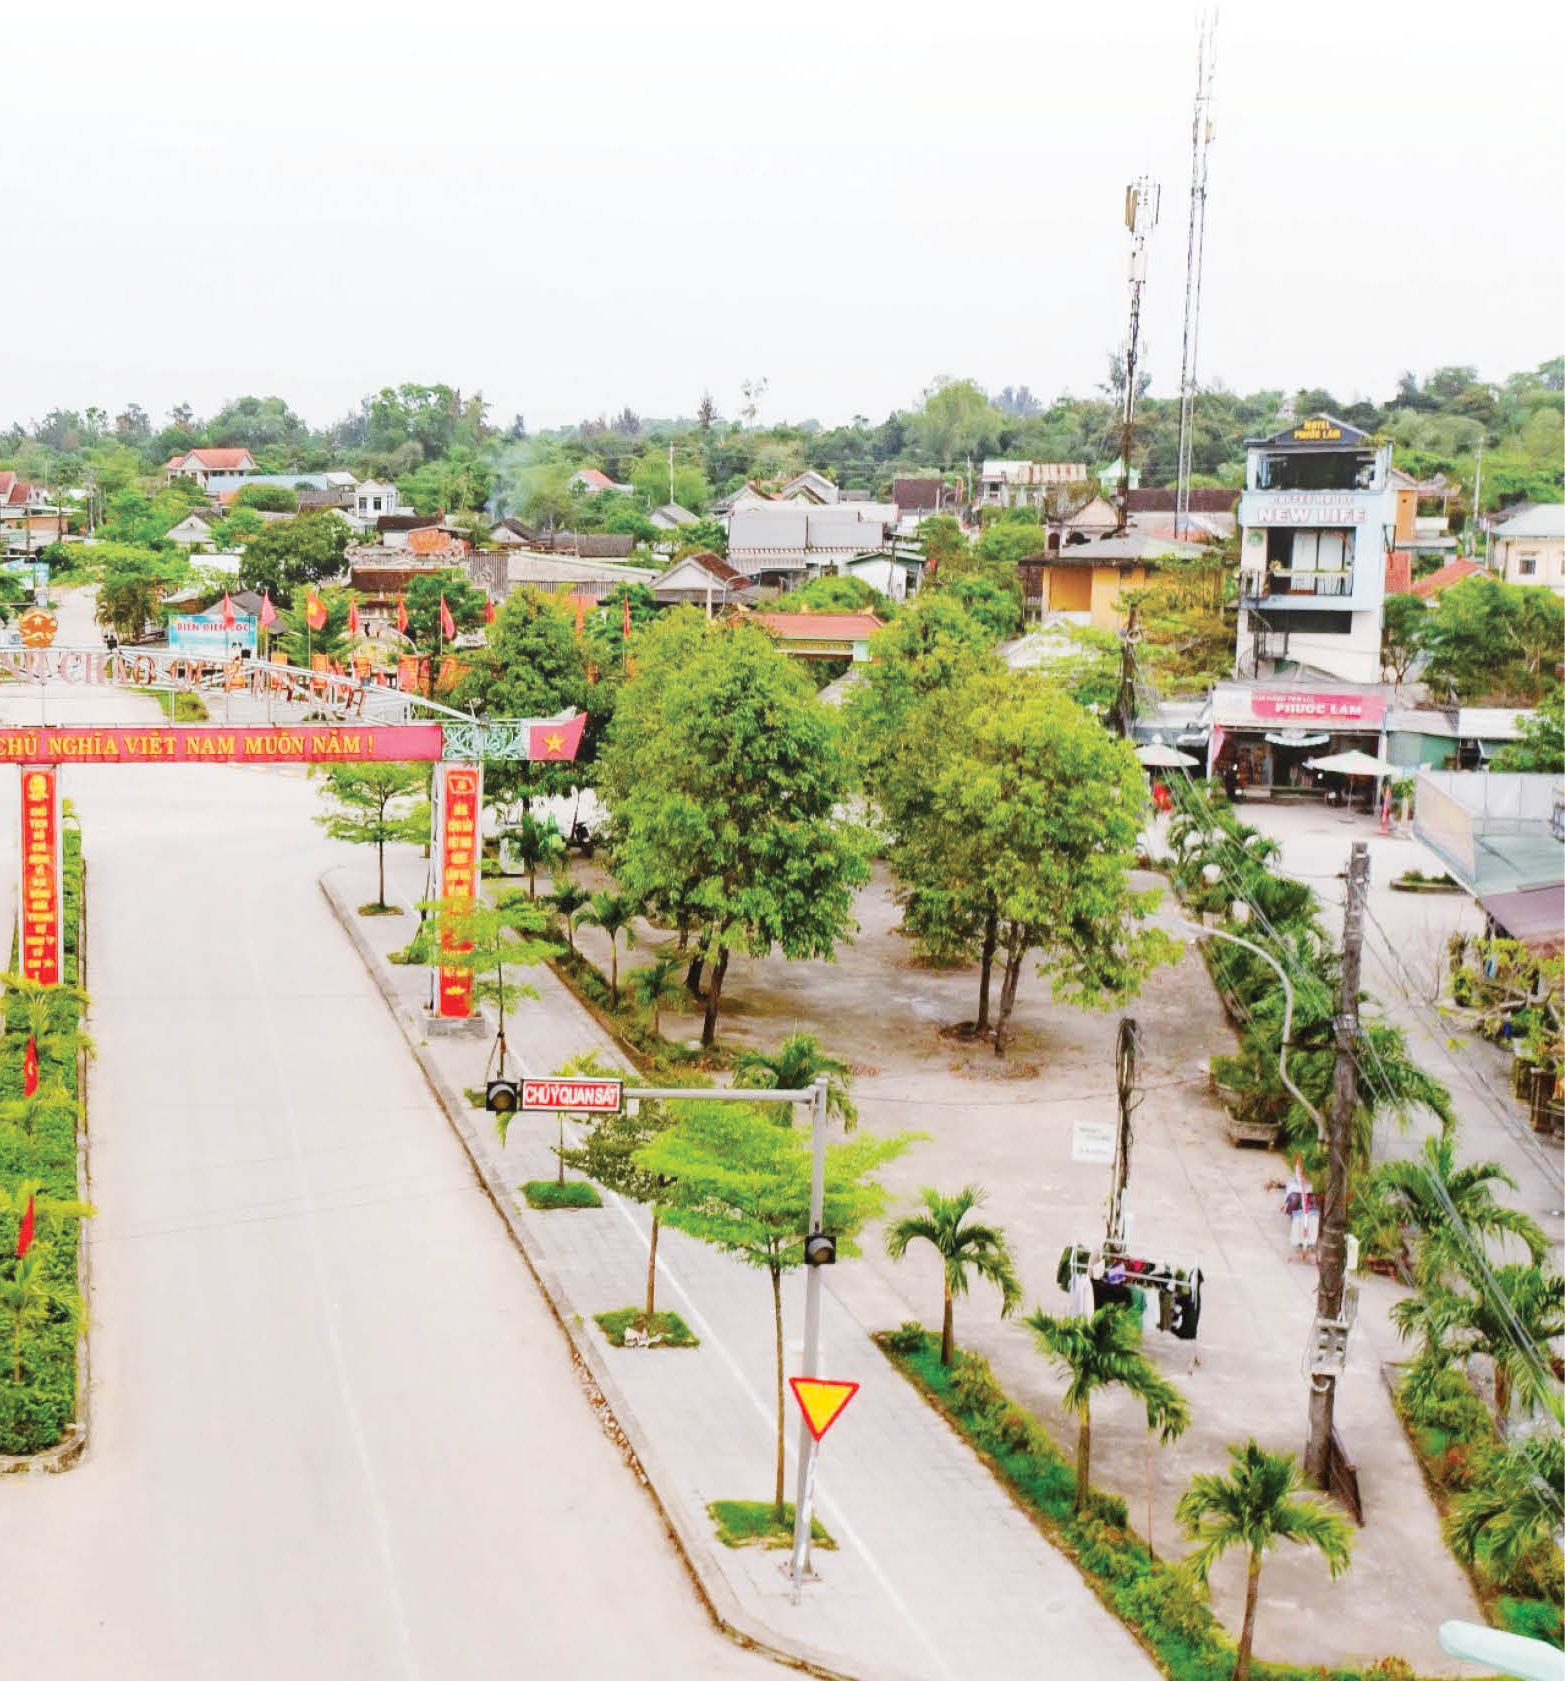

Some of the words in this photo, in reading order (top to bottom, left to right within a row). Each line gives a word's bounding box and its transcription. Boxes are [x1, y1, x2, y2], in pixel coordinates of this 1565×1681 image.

[1258, 508, 1308, 523] NEW
[1317, 508, 1365, 523] LIFE
[49, 733, 117, 755] NGHĨA
[124, 732, 178, 758] VIỆT
[186, 737, 235, 755] NAM
[244, 732, 305, 755] MUÔN
[312, 731, 362, 754] NĂM
[526, 1081, 550, 1104] CHÚ
[560, 1086, 594, 1105] QUAN
[595, 1082, 618, 1104] SÁT
